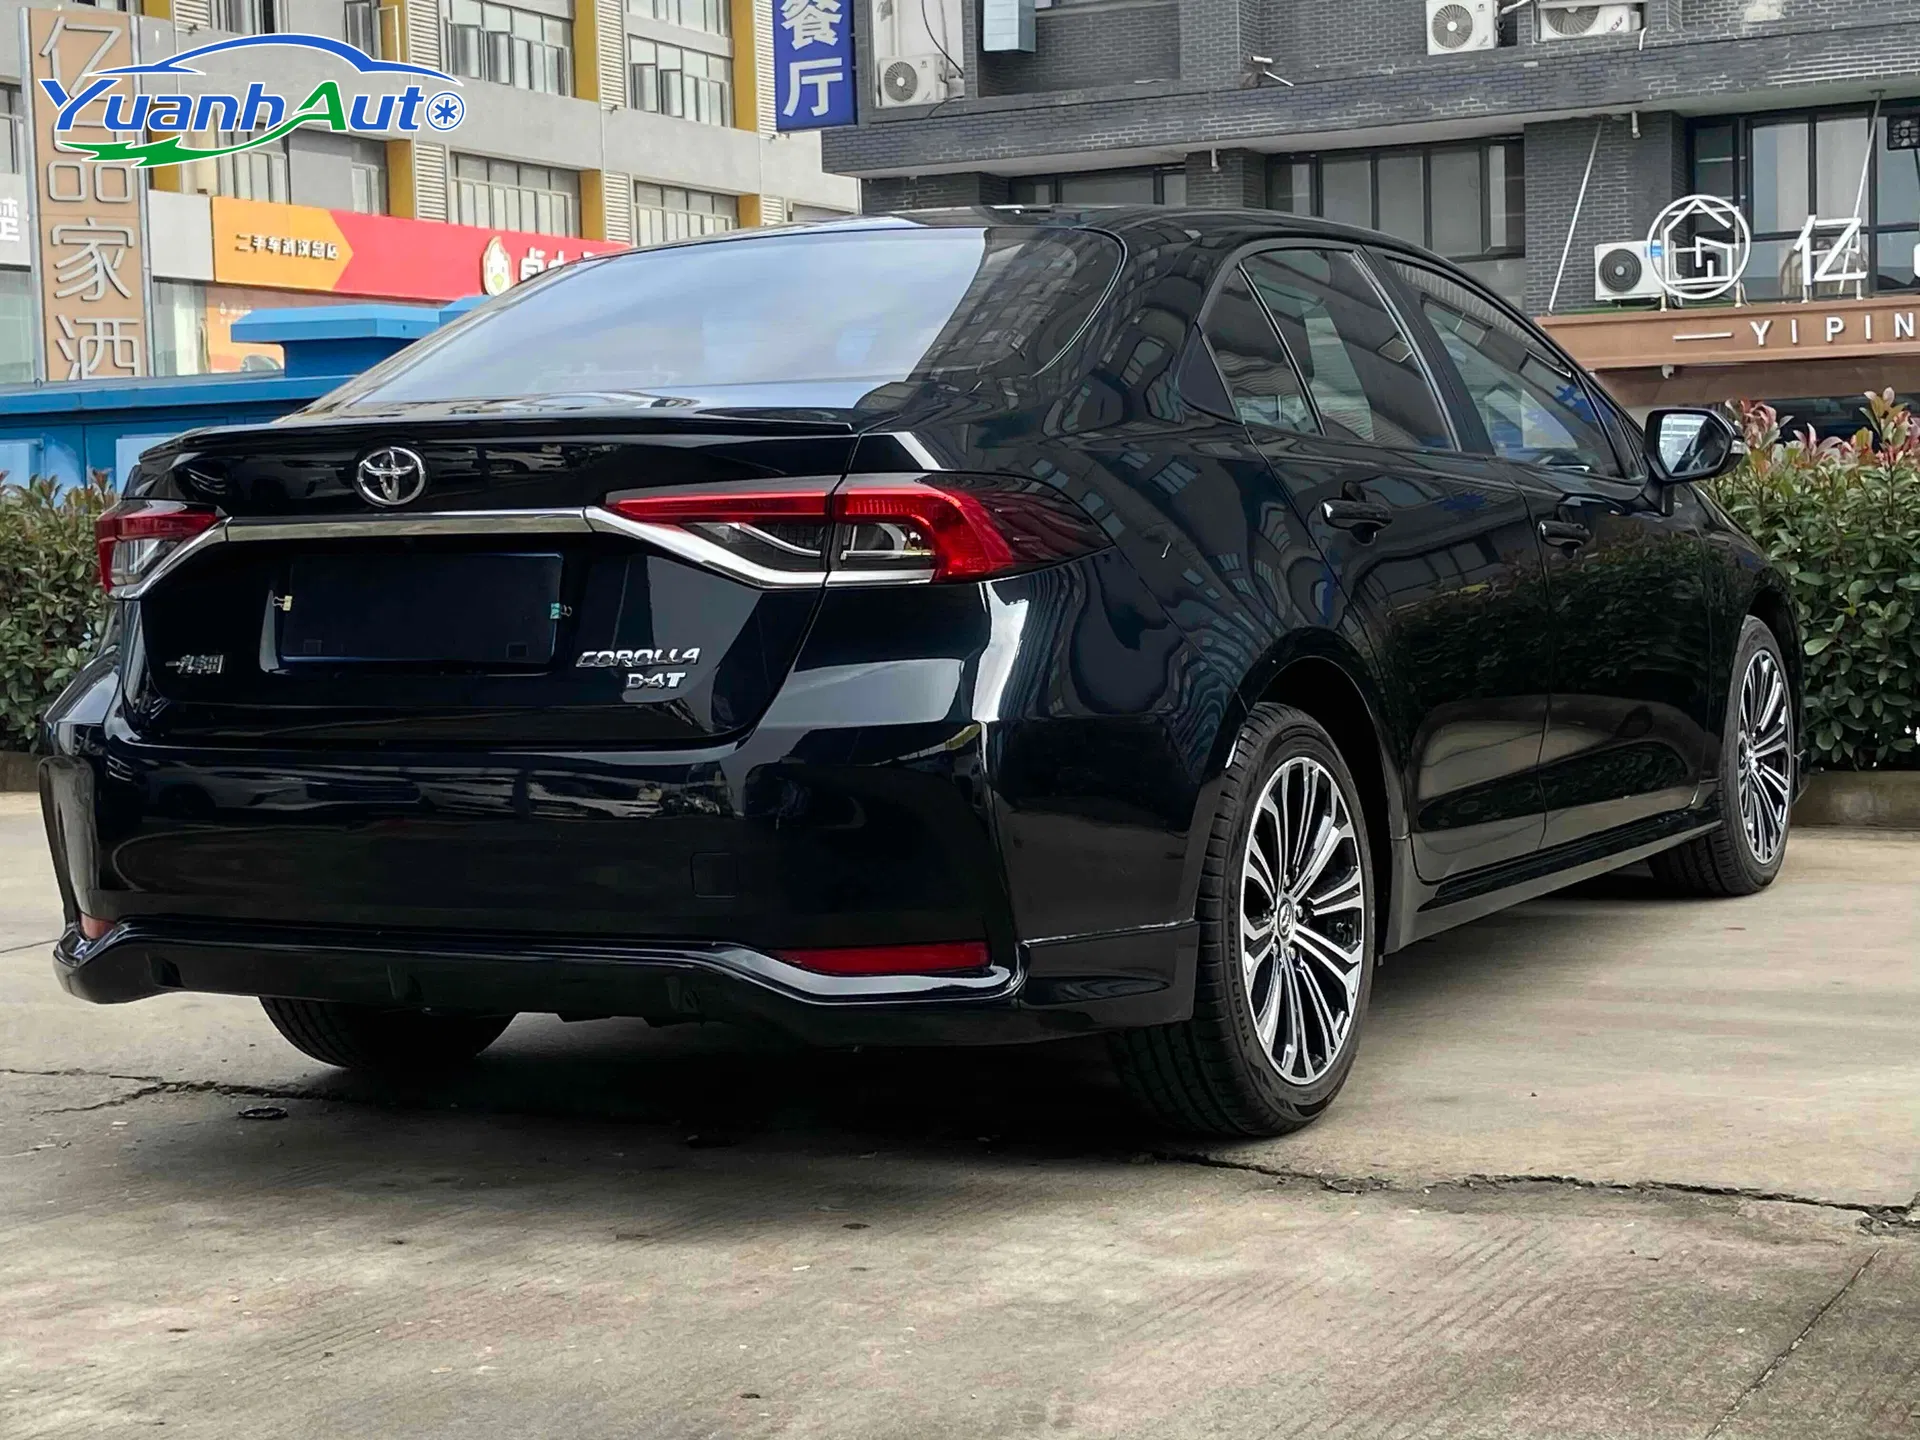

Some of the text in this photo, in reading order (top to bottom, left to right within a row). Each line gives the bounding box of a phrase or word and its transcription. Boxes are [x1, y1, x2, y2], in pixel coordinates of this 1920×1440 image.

[781, 0, 843, 117] 餐厅
[235, 234, 339, 260] 二手车武汉总店
[1750, 313, 1916, 347] YIPIN
[575, 647, 700, 667] COROLLA
